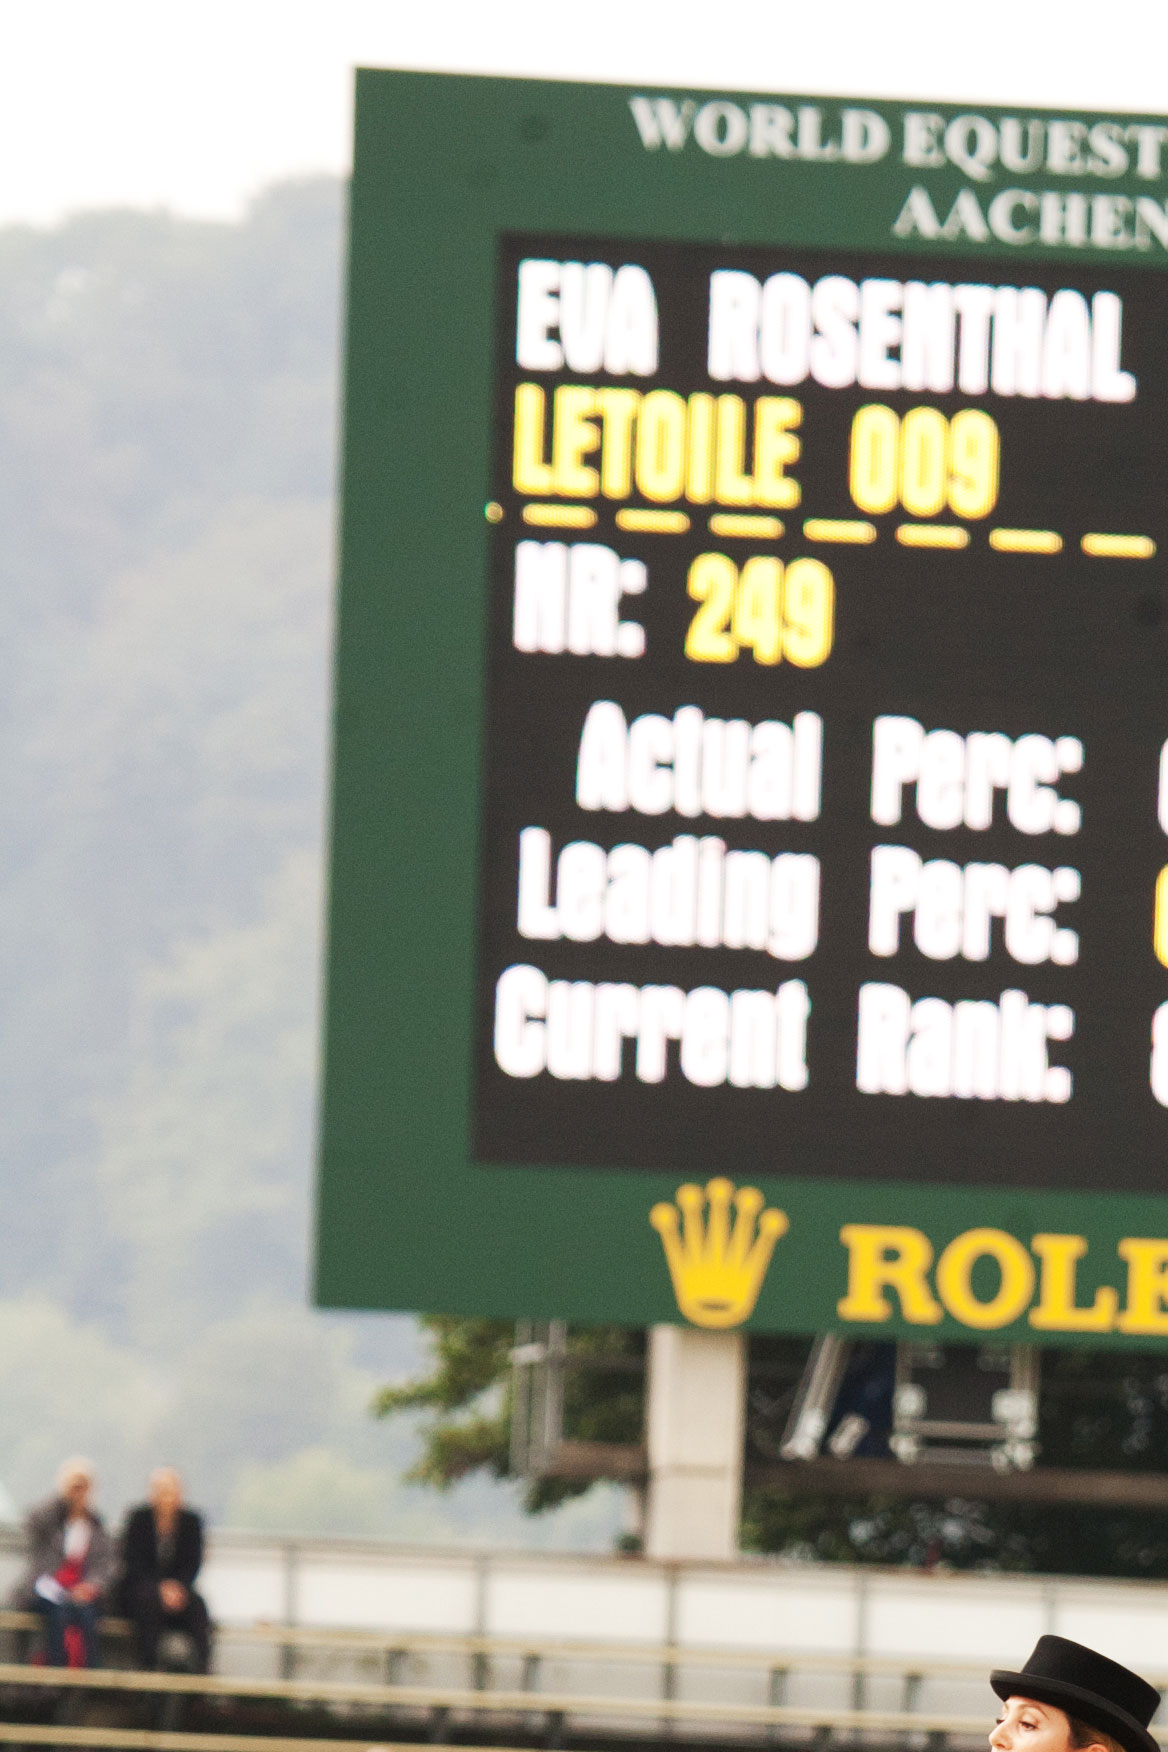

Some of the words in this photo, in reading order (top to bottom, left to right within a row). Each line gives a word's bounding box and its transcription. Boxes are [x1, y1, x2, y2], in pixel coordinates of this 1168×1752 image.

[629, 96, 892, 164] WORLD
[515, 259, 660, 376] EVA
[707, 270, 1137, 403] ROSENTHAL
[512, 382, 804, 510] LETOILE
[847, 403, 1001, 521] 009
[684, 552, 836, 670] 249
[575, 700, 824, 823] Actual
[869, 715, 1084, 836] Perc:
[516, 826, 822, 962] Leading
[867, 844, 1082, 966] Perc:
[493, 964, 812, 1093] Current
[855, 982, 1075, 1104] Rank:
